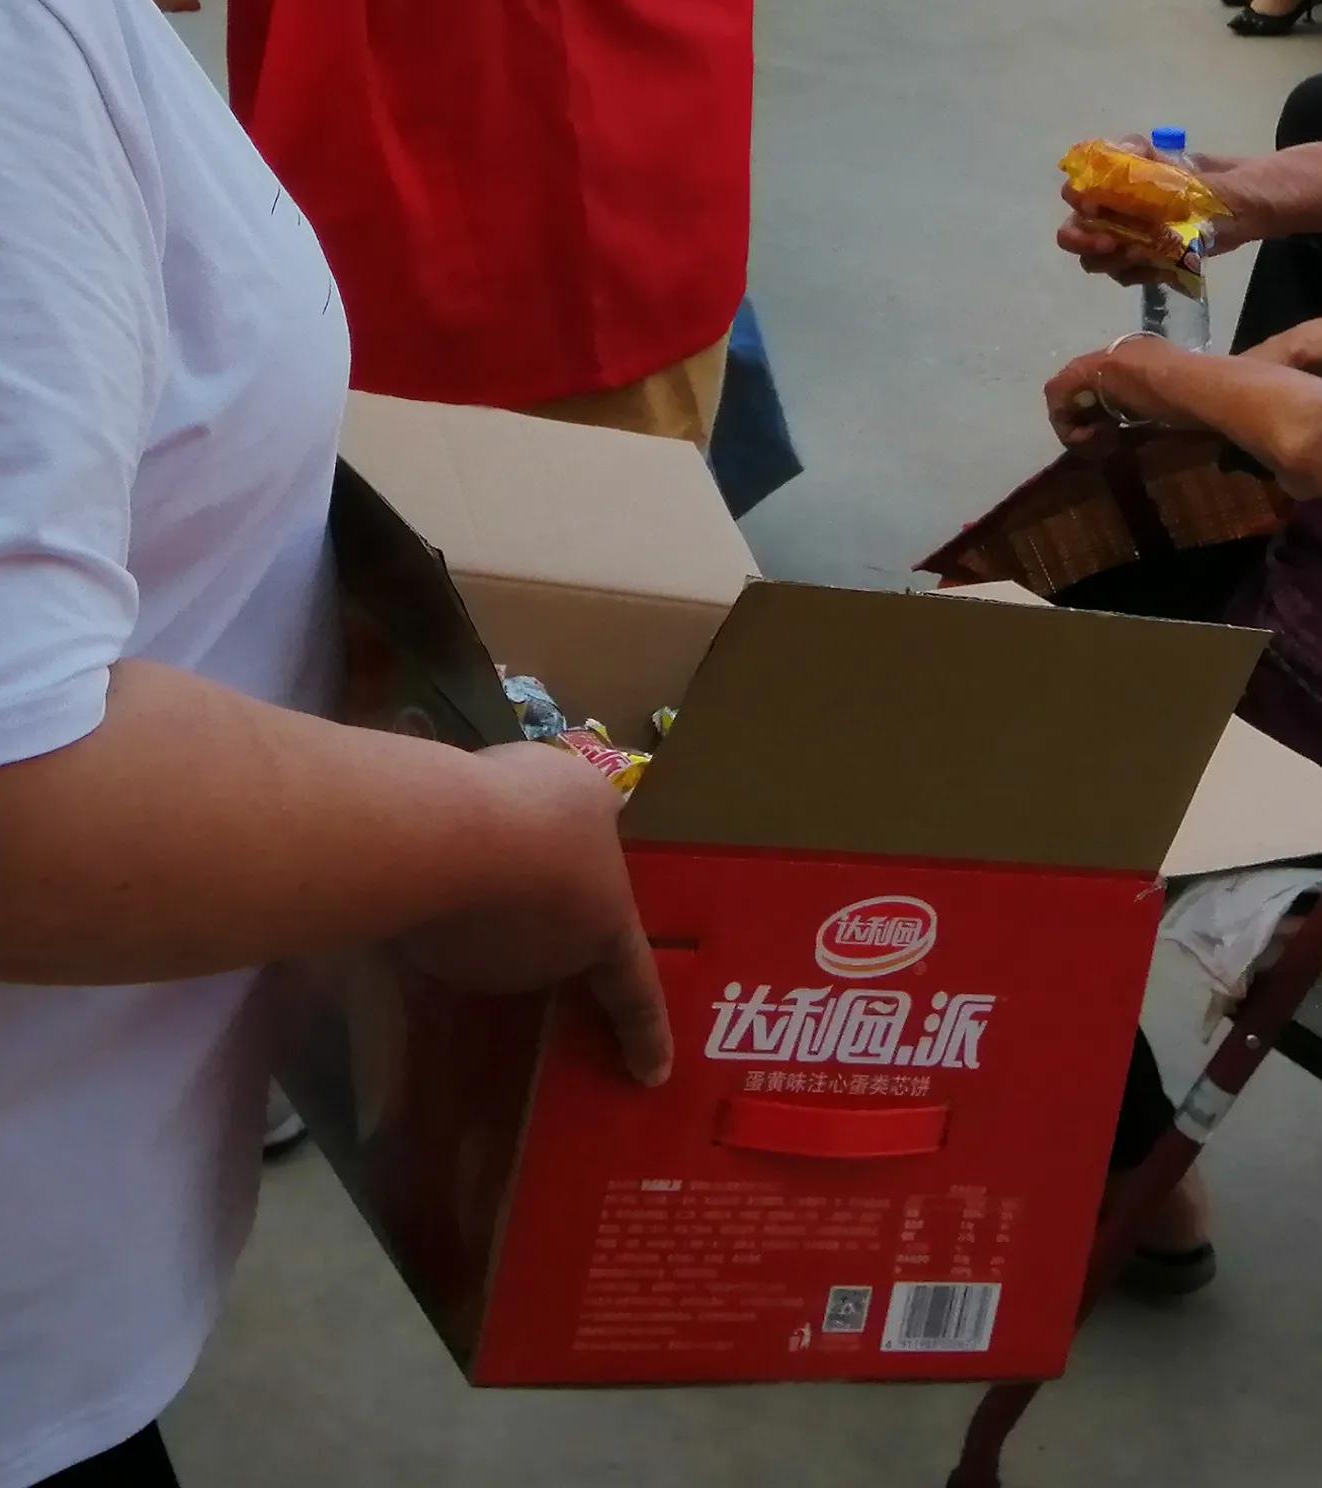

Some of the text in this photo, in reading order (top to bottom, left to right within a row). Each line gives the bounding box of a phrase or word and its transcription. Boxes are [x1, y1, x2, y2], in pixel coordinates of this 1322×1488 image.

[834, 911, 924, 947] 达利园
[742, 1070, 932, 1098] 蛋黄味注心蛋类芯饼
